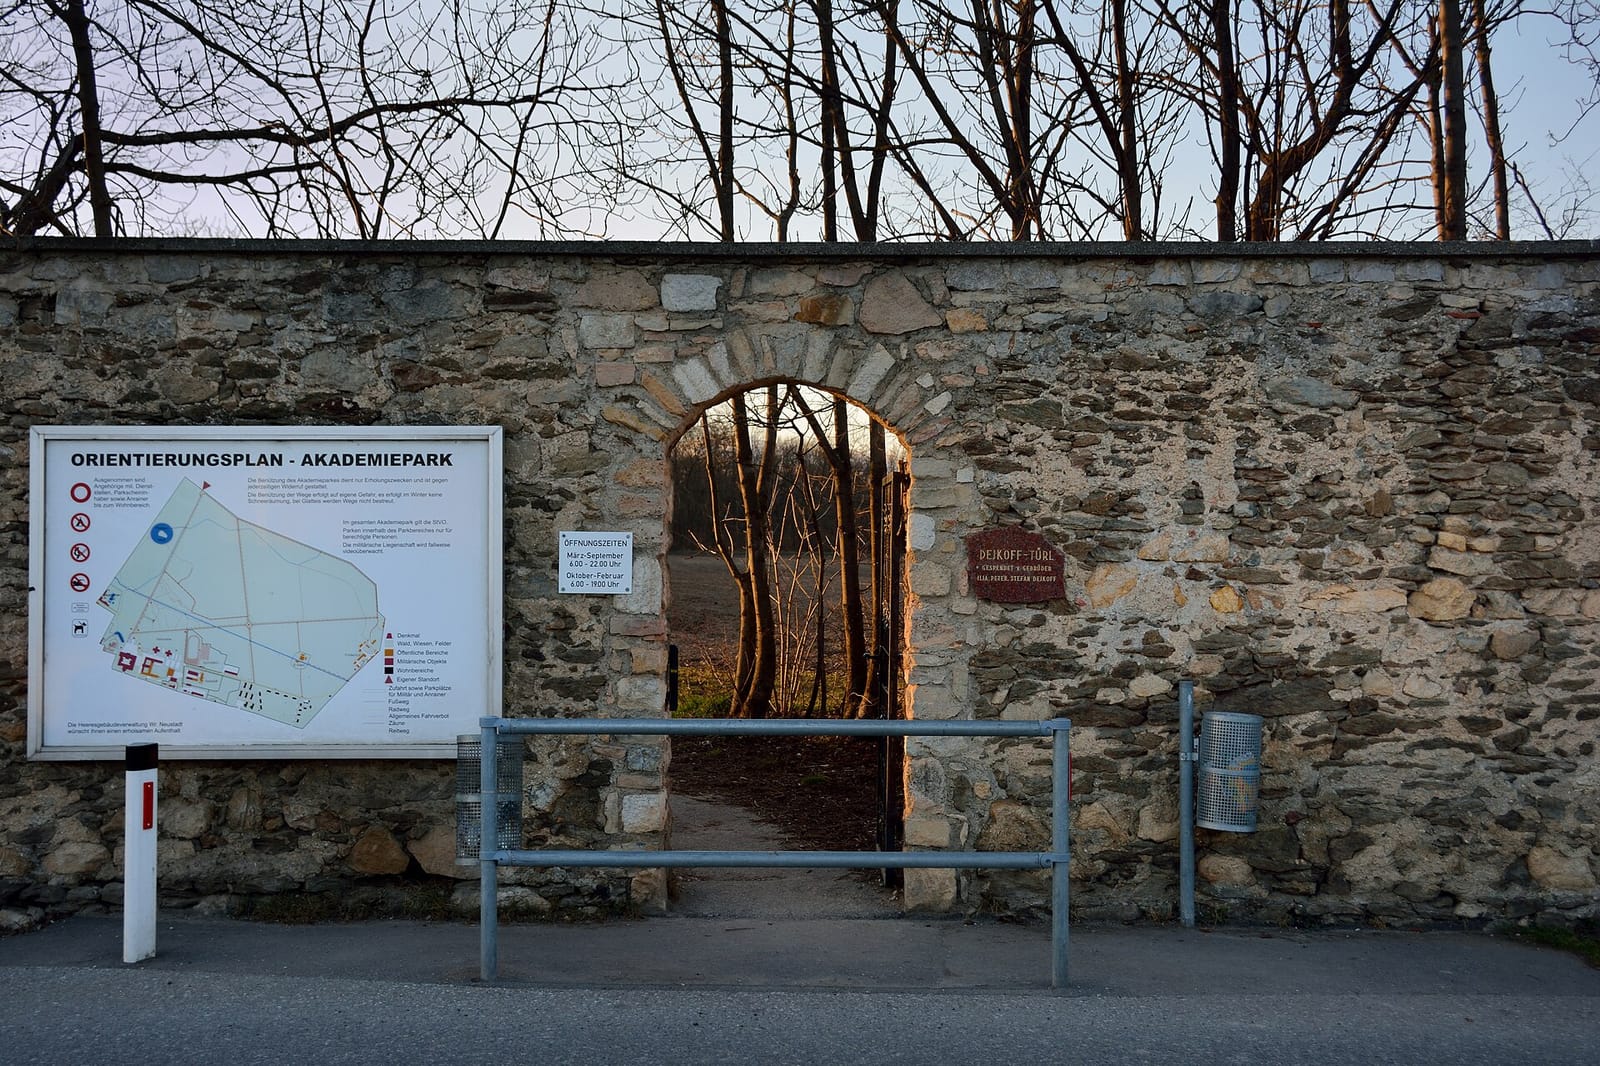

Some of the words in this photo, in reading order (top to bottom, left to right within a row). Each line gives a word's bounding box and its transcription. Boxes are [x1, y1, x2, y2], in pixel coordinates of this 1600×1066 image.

[71, 453, 283, 467] ORIENTIERUNGSPLAN
[301, 453, 453, 467] AKADEMIEPARK
[979, 548, 1054, 561] DEJKOFF-TÜRL
